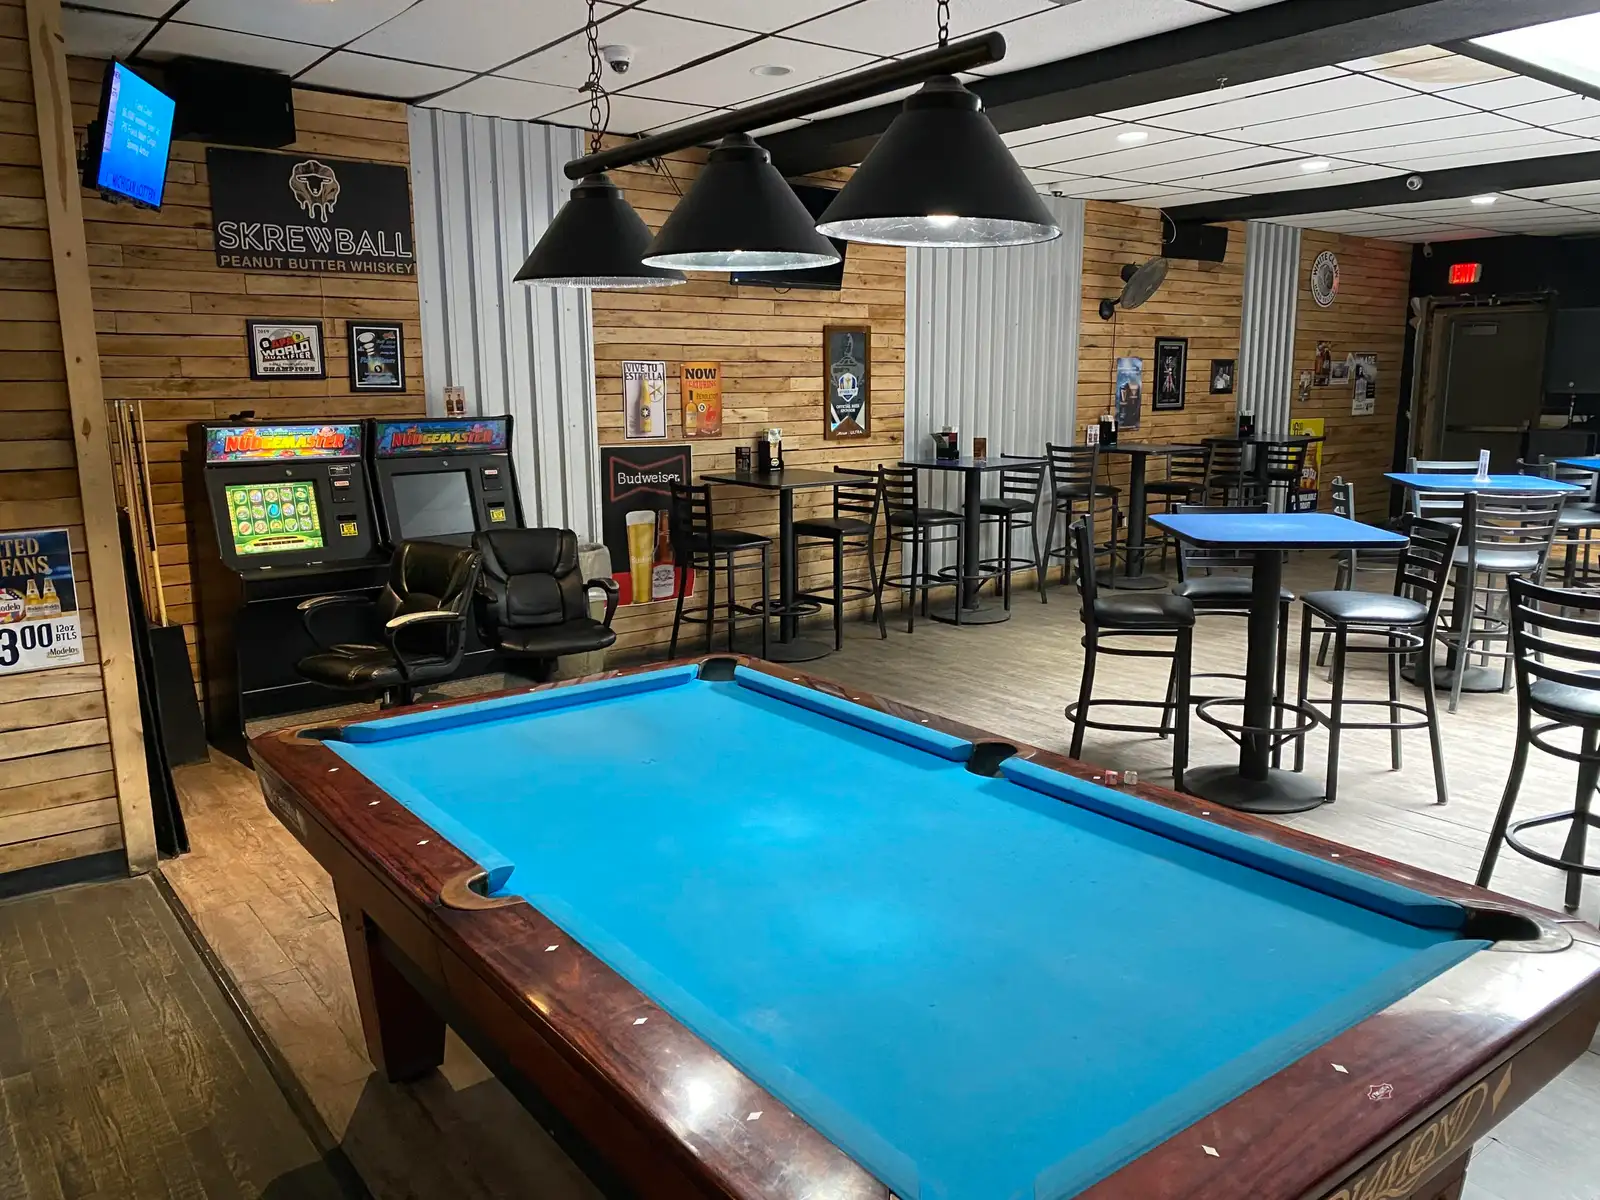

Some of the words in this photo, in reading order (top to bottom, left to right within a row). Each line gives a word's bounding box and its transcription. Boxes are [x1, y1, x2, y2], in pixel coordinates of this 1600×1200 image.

[218, 221, 412, 258] SKREWBALL
[220, 255, 284, 269] PEANUT
[289, 258, 346, 271] BUTTER
[350, 261, 413, 274] WHISKEY
[1313, 252, 1328, 276] WHITE
[1328, 253, 1339, 277] CLAW
[1451, 264, 1476, 283] EXIT
[262, 341, 310, 357] WORLD
[265, 352, 311, 360] QUALIFIER
[625, 364, 645, 372] VIVE
[647, 364, 658, 372] TU
[685, 368, 717, 379] NOW
[625, 372, 663, 381] ESTRELLA
[617, 472, 679, 485] Budweiser
[0, 537, 39, 558] TED
[1, 556, 51, 577] FANS
[0, 602, 20, 612] odelo
[56, 624, 75, 633] 12oz
[56, 631, 77, 642] BTLS
[48, 646, 77, 656] Modelo
[1328, 1083, 1488, 1200] IAMOND
